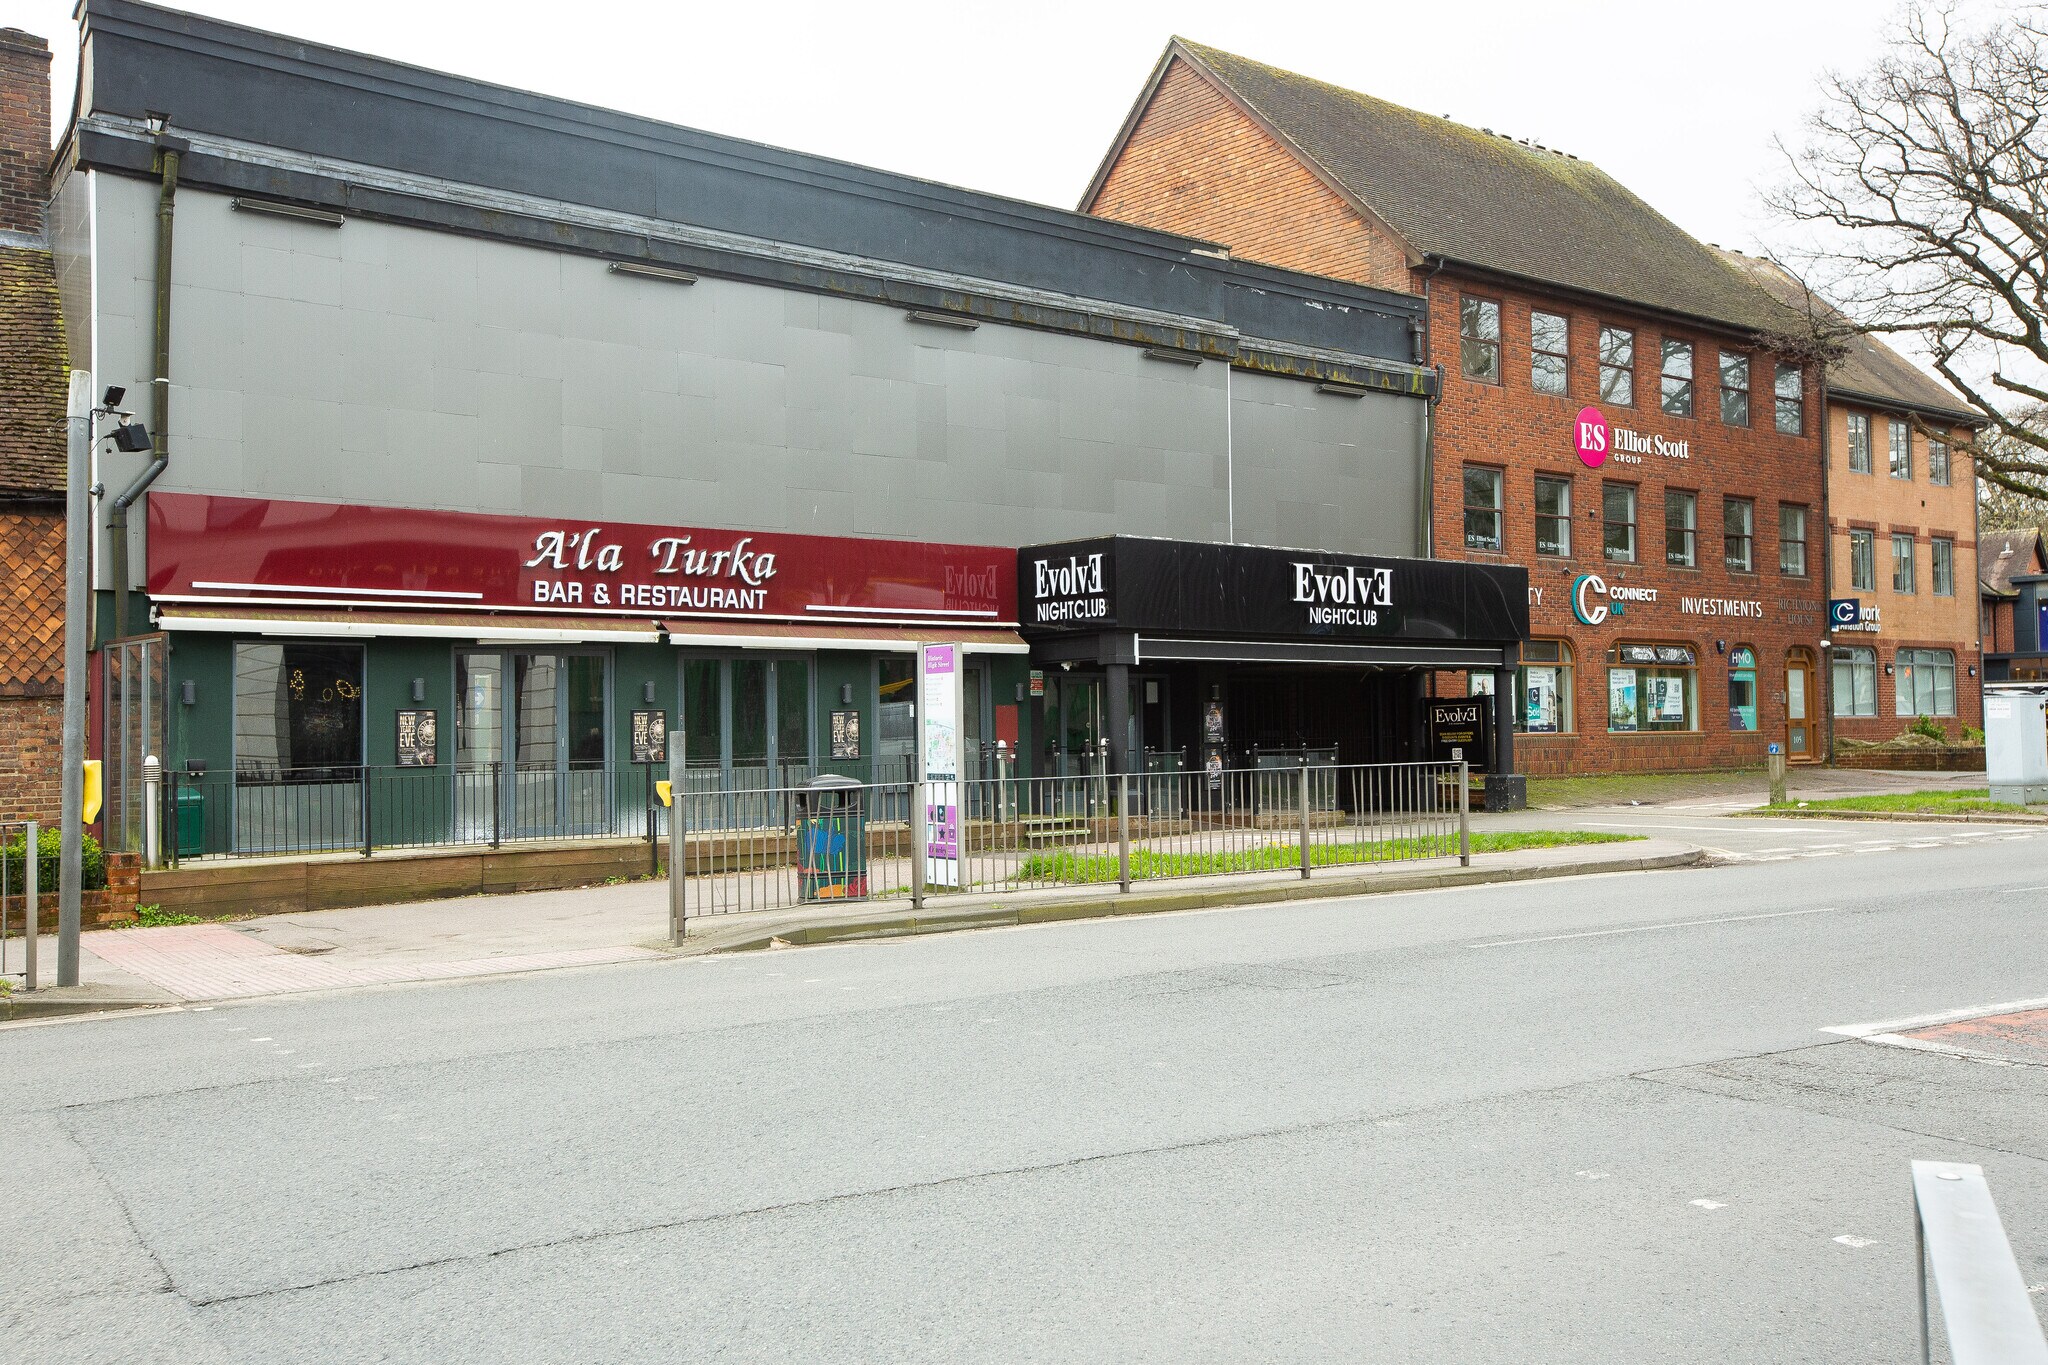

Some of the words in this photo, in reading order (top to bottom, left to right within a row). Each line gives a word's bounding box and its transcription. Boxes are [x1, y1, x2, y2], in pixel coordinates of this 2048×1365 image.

[1580, 422, 1606, 452] ES
[1613, 428, 1652, 454] Elliot
[1654, 434, 1690, 459] Scott
[1613, 454, 1642, 464] GROUP
[522, 528, 623, 572] A'la
[649, 535, 777, 586] Turka
[534, 580, 583, 604] BAR
[593, 583, 611, 605] &
[620, 583, 768, 610] RESTAURANT
[1610, 586, 1658, 602] CONNECT
[1037, 598, 1106, 621] NIGHTCLUB
[1610, 602, 1624, 616] UK
[1681, 597, 1763, 618] INVESTMENTS
[1309, 607, 1378, 626] NIGHTCLUB
[1788, 614, 1814, 626] HOUSE
[1864, 620, 1881, 634] Group
[1732, 652, 1750, 664] HMO
[400, 716, 416, 726] NEW
[634, 716, 648, 724] NEW
[400, 732, 416, 747] EVE
[634, 732, 648, 744] EVE
[1794, 736, 1802, 744] 105
